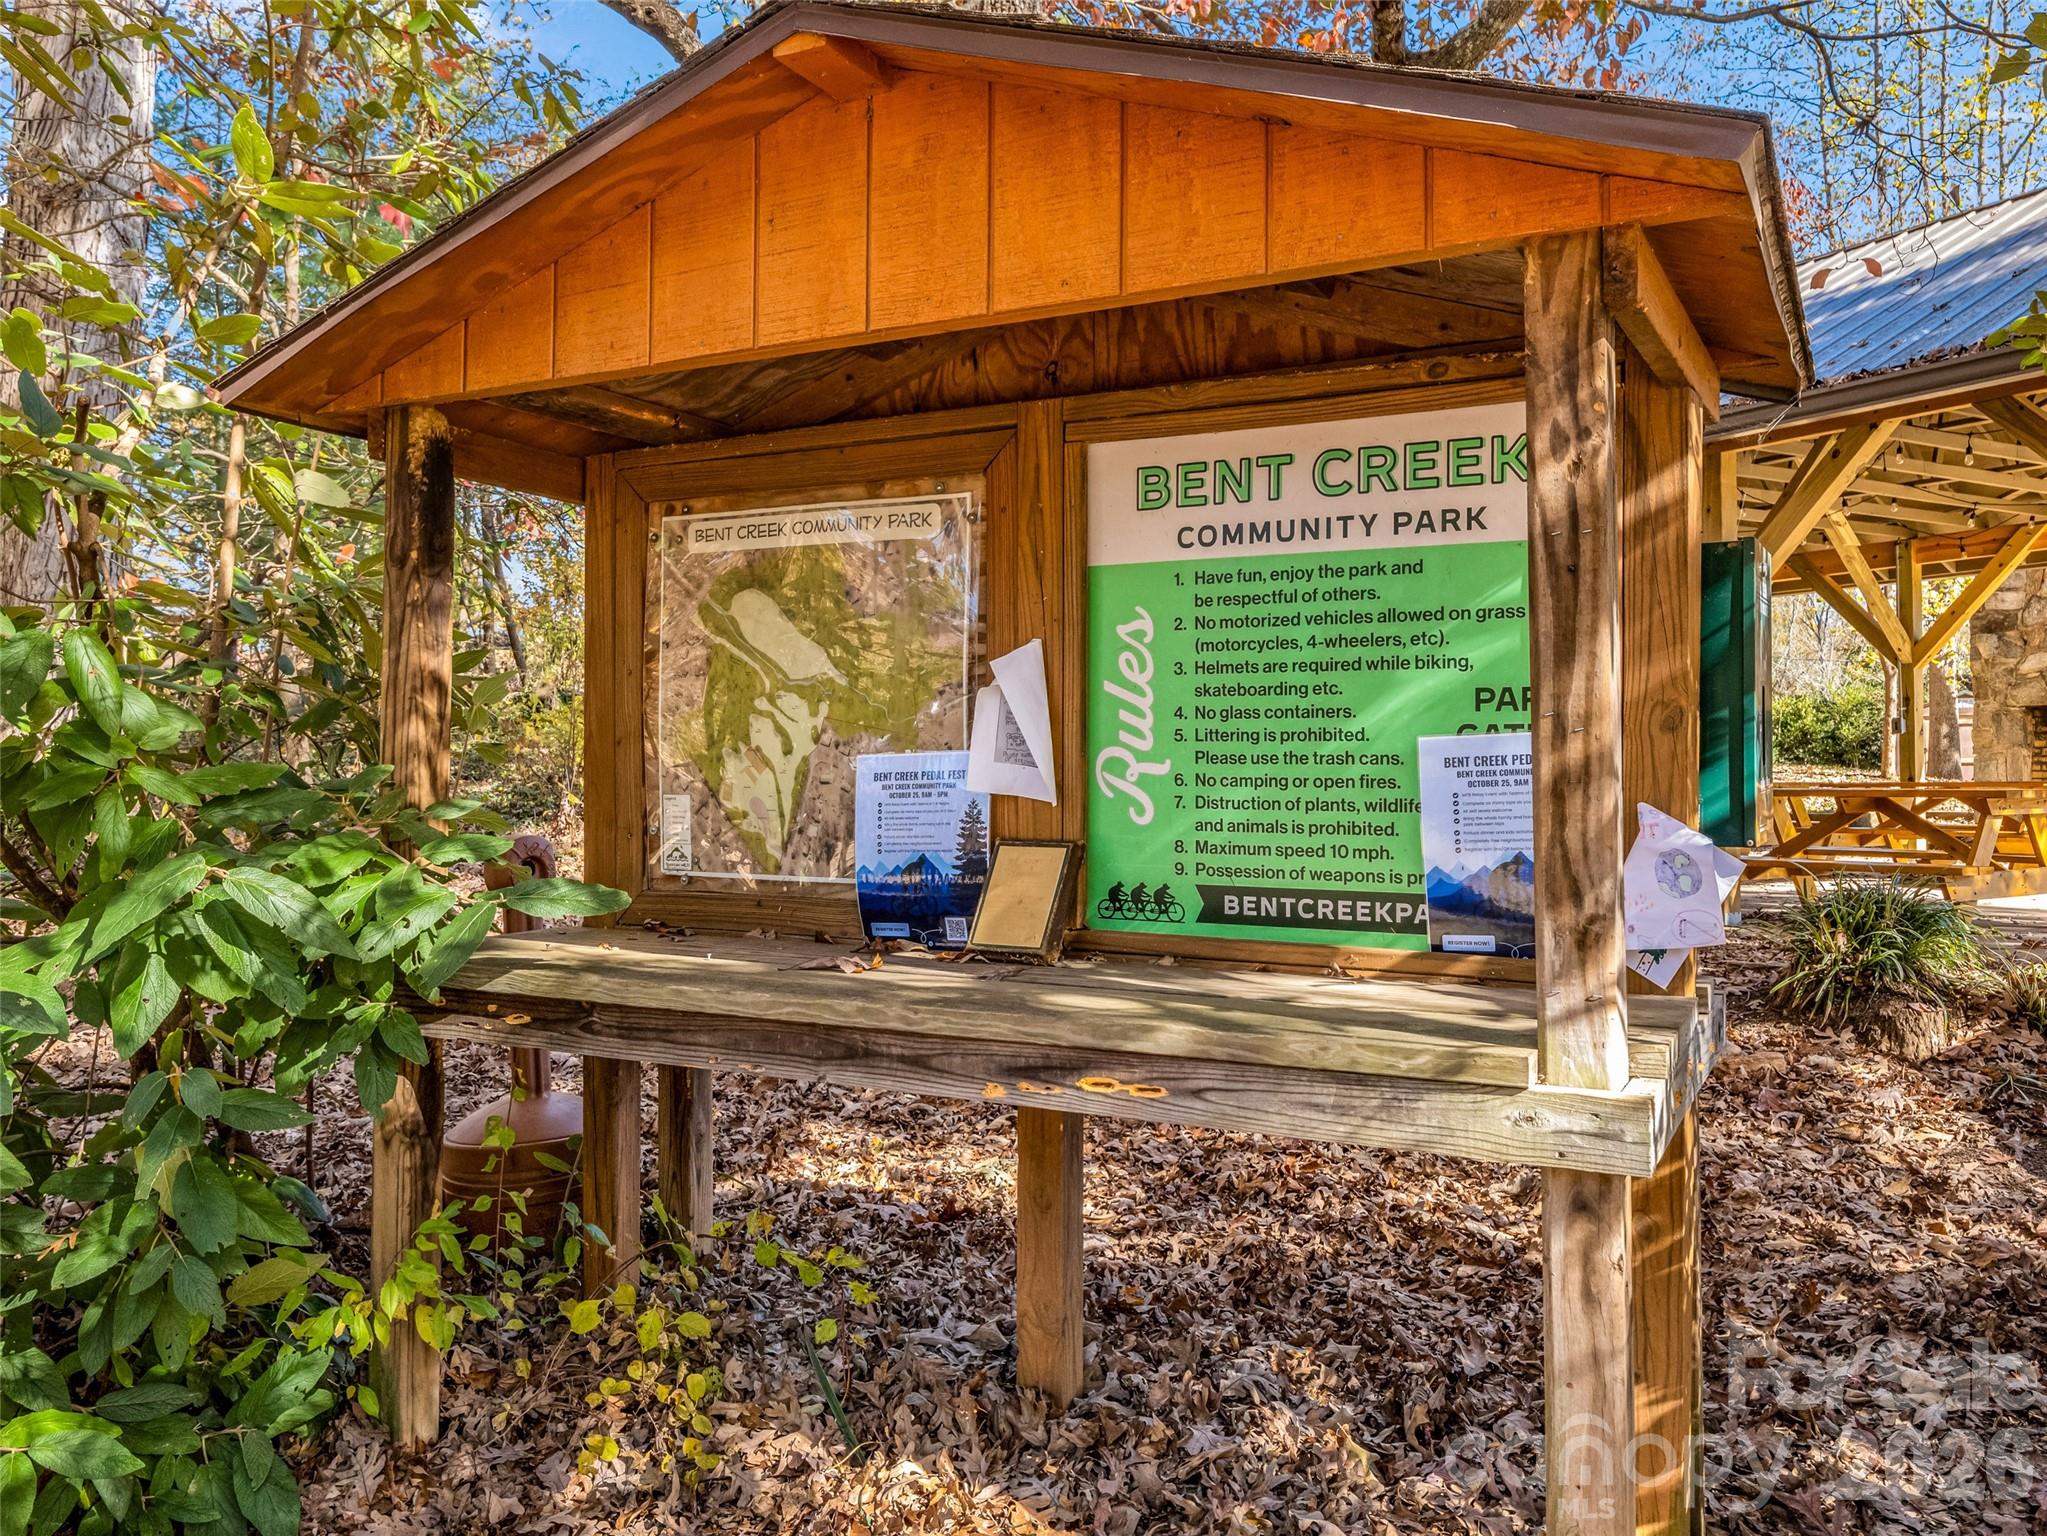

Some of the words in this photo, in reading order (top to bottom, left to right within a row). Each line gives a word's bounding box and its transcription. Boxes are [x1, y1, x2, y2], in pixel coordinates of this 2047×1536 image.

[1137, 453, 1295, 511] BENT
[1312, 433, 1527, 497] CREEK
[695, 527, 732, 543] BENT
[737, 522, 788, 540] CREEK
[792, 515, 883, 535] COMMUNITY
[888, 512, 933, 529] PARK
[1177, 513, 1378, 549] COMMUNITY
[1393, 506, 1488, 535] PARK
[1173, 572, 1185, 587] 1.
[1194, 570, 1234, 586] Have
[1236, 568, 1267, 585] fun,
[1269, 565, 1315, 584] enjoy
[1317, 563, 1345, 579] the
[1348, 560, 1388, 581] park
[1390, 558, 1424, 576] and
[1194, 593, 1214, 608] be
[1216, 588, 1298, 609] respectful
[1301, 587, 1319, 603] of
[1321, 586, 1381, 602] others.
[1173, 616, 1187, 632] 2.
[1194, 615, 1217, 631] No
[1219, 611, 1301, 630] motorized
[1304, 609, 1374, 626] vehicles
[1376, 605, 1445, 624] allowed
[1448, 608, 1472, 621] on
[1475, 606, 1526, 624] grass
[1195, 635, 1303, 655] (motorcycles,
[1306, 632, 1407, 649] 4-wheelers,
[1409, 629, 1450, 648] etc).
[1173, 661, 1188, 676] 3.
[1194, 659, 1260, 675] Helmets
[1262, 661, 1289, 674] are
[1291, 656, 1362, 676] required
[1365, 654, 1411, 671] while
[1414, 653, 1474, 673] biking,
[1194, 681, 1309, 699] skateboarding
[1311, 681, 1344, 697] etc.
[1096, 606, 1171, 825] Rules
[1173, 705, 1188, 720] 4.
[1194, 705, 1217, 720] No
[1219, 704, 1261, 723] glass
[1263, 703, 1357, 720] containers.
[1173, 728, 1188, 743] 5.
[1194, 727, 1260, 746] Littering
[1263, 727, 1277, 743] is
[1279, 726, 1370, 745] prohibited.
[1194, 750, 1248, 765] Please
[1250, 753, 1280, 765] use
[1282, 750, 1310, 766] the
[1312, 750, 1356, 766] trash
[1358, 753, 1405, 766] cans.
[1444, 757, 1470, 768] BENT
[1474, 755, 1508, 767] CREEK
[1512, 754, 1532, 766] PED
[874, 772, 894, 782] BENT
[895, 771, 919, 781] CREEK
[921, 770, 945, 780] PEDAL
[948, 769, 966, 779] FEST
[1174, 772, 1188, 787] 6.
[1194, 772, 1217, 788] No
[1219, 773, 1289, 792] camping
[1291, 776, 1310, 789] or
[1312, 777, 1356, 792] open
[1358, 773, 1401, 790] fires.
[1457, 770, 1473, 778] BENT
[1476, 769, 1497, 777] CREEK
[1468, 780, 1499, 788] OCTOBER
[1501, 779, 1512, 787] 25,
[1173, 795, 1186, 809] 7.
[1195, 794, 1282, 811] Distruction
[1284, 796, 1302, 812] of
[1304, 796, 1361, 816] plants,
[1194, 817, 1224, 833] and
[1226, 818, 1289, 834] animals
[1291, 819, 1305, 835] is
[1308, 820, 1400, 838] prohibited.
[1174, 839, 1189, 854] 8.
[1195, 839, 1272, 857] Maximum
[1274, 843, 1326, 860] speed
[1329, 844, 1350, 859] 10
[1352, 844, 1395, 863] mph.
[1174, 861, 1189, 876] 9.
[1195, 861, 1286, 880] Possession
[1288, 865, 1306, 881] of
[1308, 869, 1386, 885] weapons
[1389, 868, 1404, 885] is
[1224, 895, 1428, 924] BENTCREEKPA
